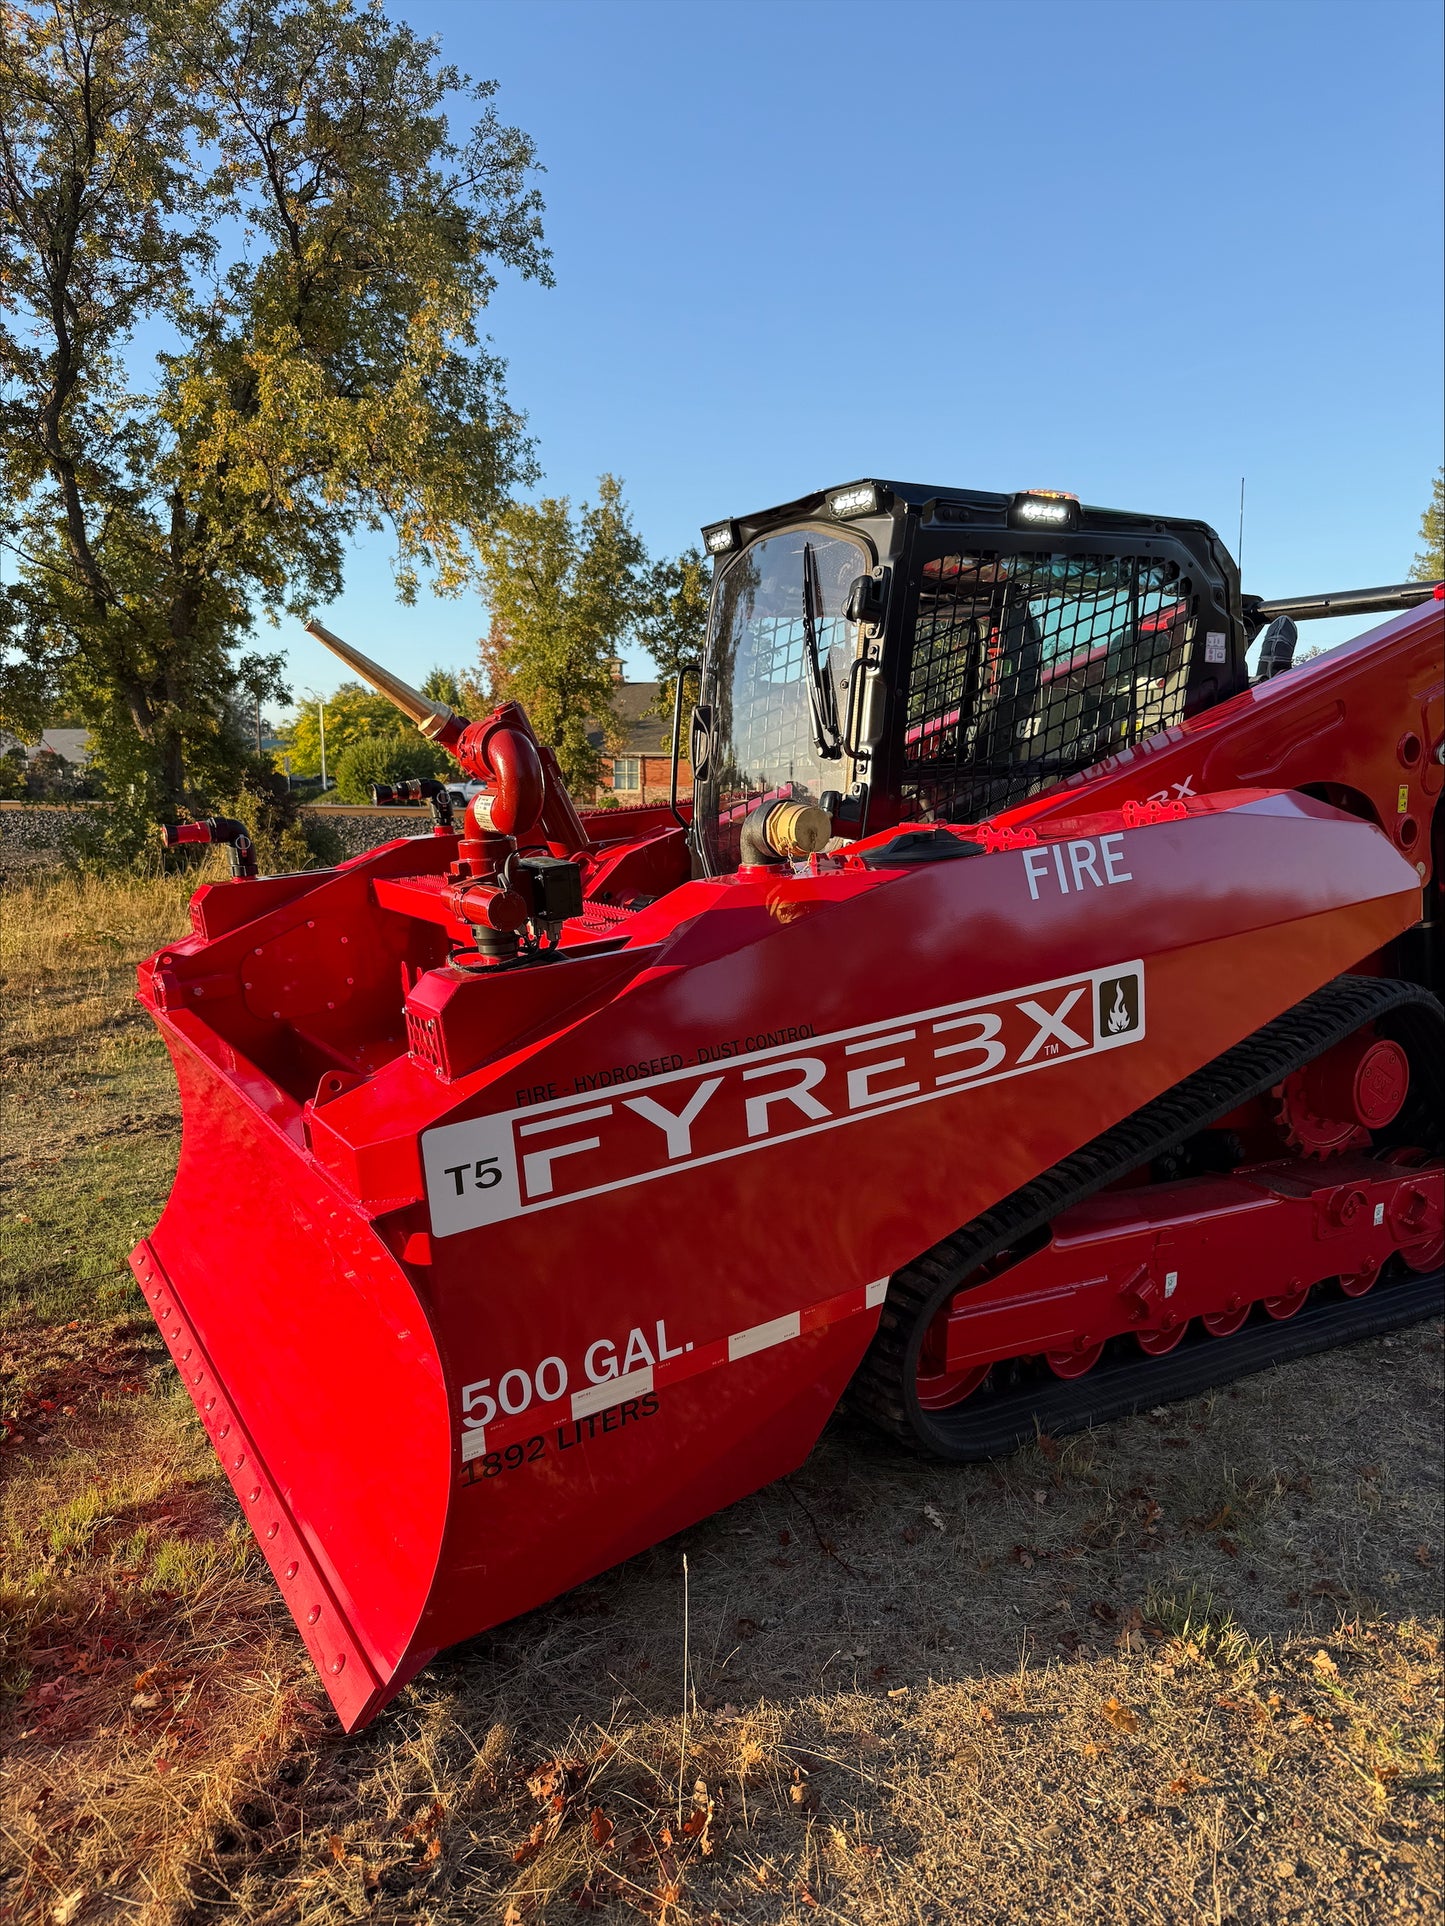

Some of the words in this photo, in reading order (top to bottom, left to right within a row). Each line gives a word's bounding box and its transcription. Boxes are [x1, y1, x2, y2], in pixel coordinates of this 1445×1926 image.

[1016, 717, 1042, 739] CAT
[1022, 833, 1133, 900] FIRE
[516, 1082, 557, 1107] FIRE
[574, 1053, 684, 1095] HYDROSEED
[697, 1040, 741, 1063] DUST
[744, 1023, 818, 1054] CONTROL
[1044, 1042, 1060, 1056] TM
[444, 1156, 502, 1196] T5
[462, 1356, 568, 1428] 500
[584, 1319, 694, 1384] GAL.
[461, 1435, 545, 1488] 1892
[557, 1391, 660, 1451] LITERS
